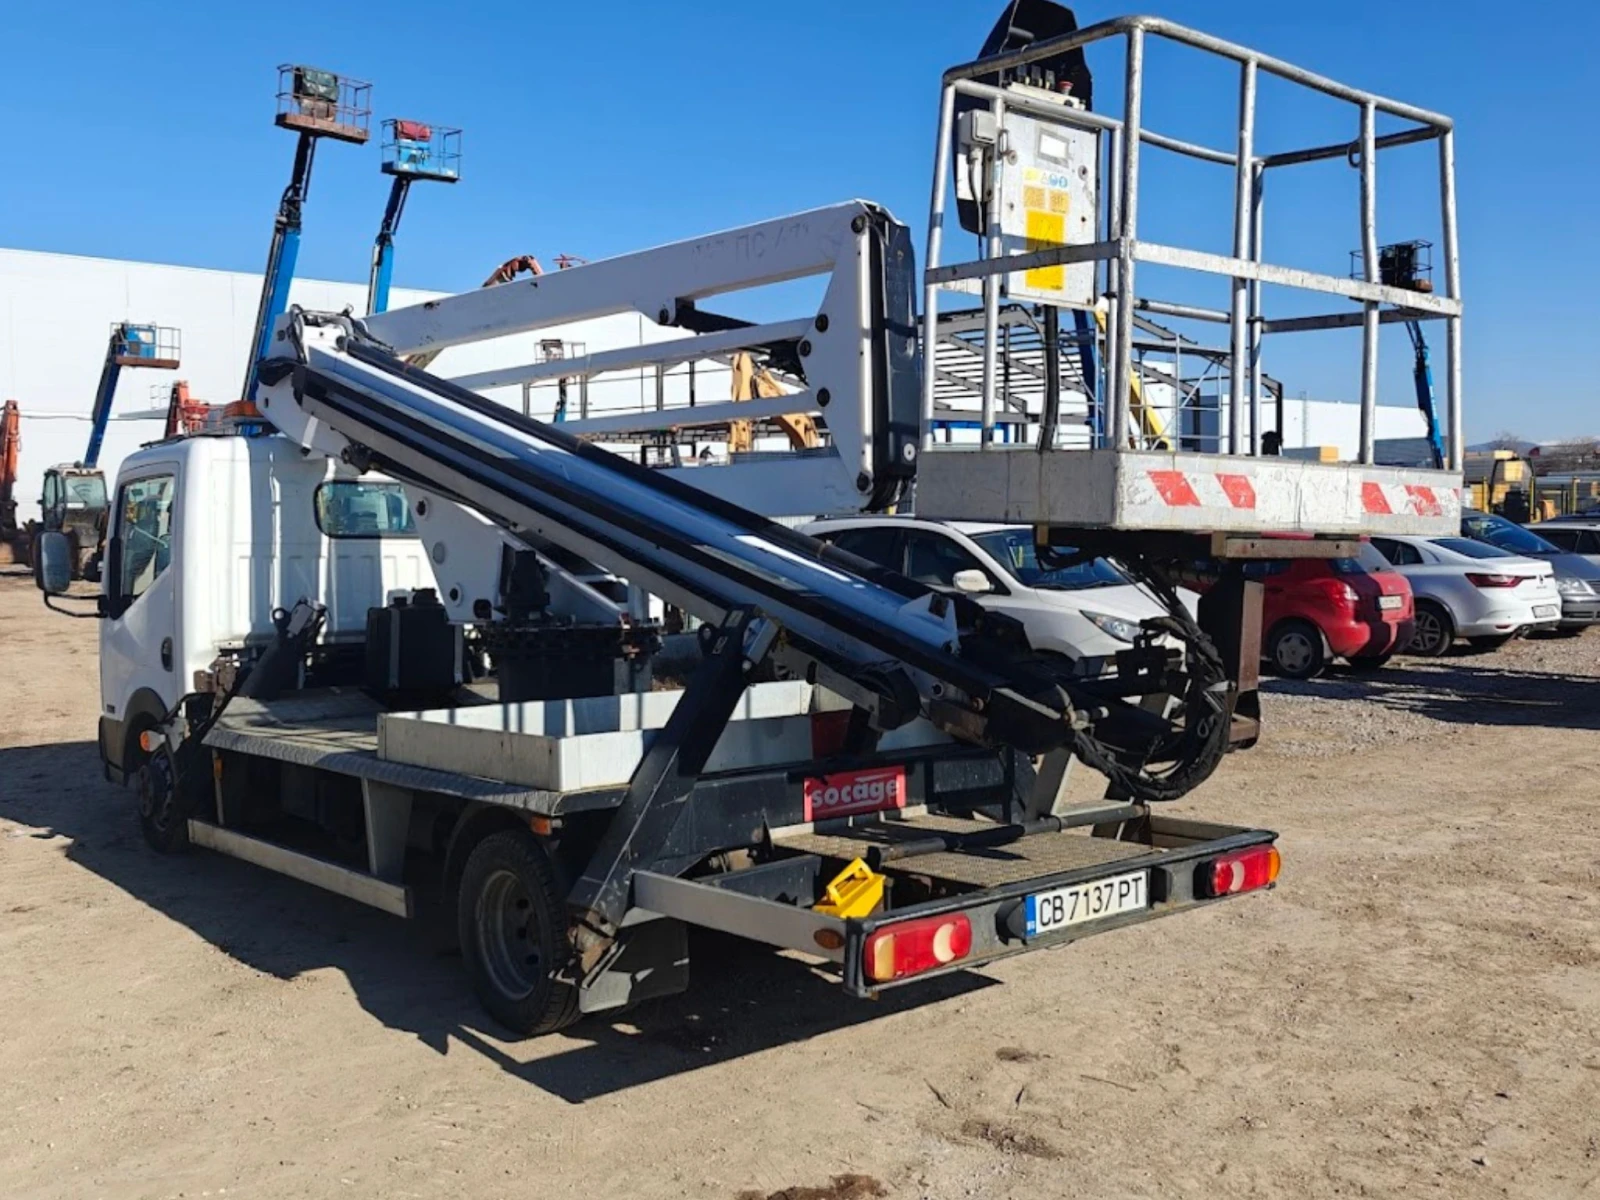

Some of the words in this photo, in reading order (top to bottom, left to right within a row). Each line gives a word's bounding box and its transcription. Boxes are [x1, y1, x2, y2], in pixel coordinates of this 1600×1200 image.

[811, 779, 898, 809] socage
[1039, 894, 1064, 927] CB
[1068, 882, 1115, 920] 7137
[1117, 876, 1143, 908] PT
